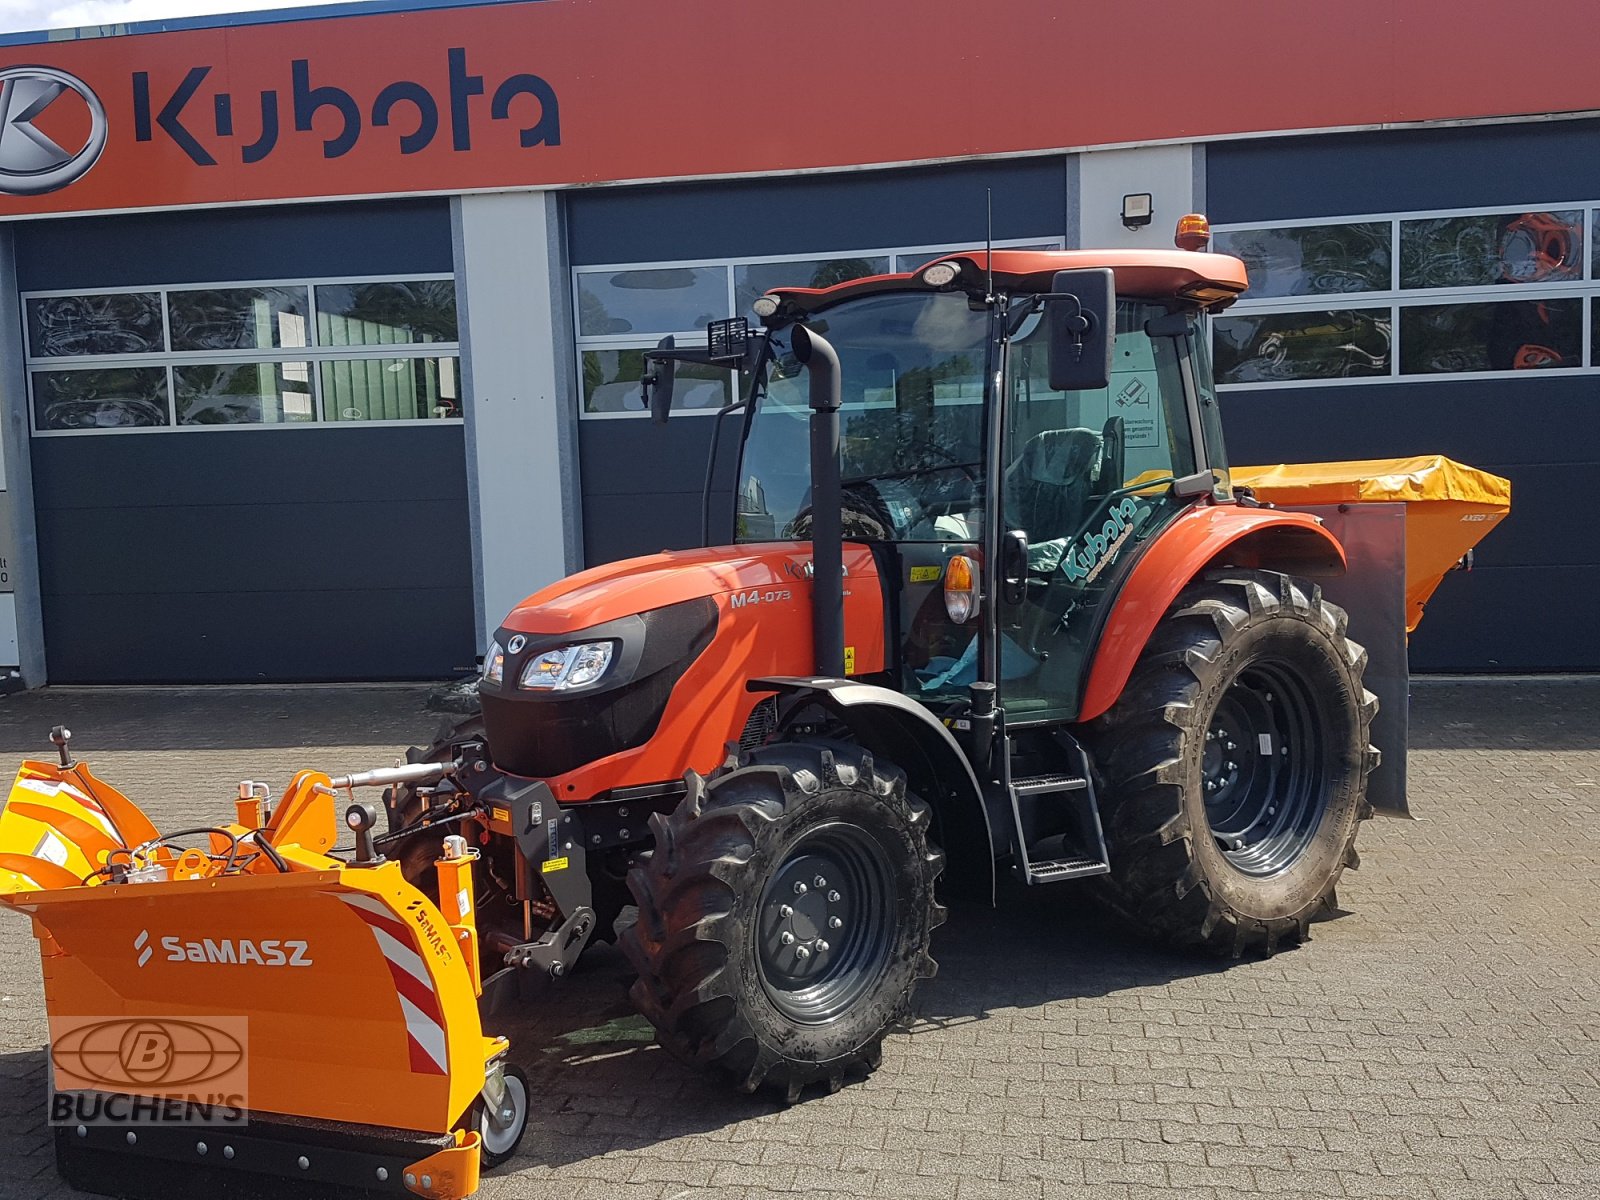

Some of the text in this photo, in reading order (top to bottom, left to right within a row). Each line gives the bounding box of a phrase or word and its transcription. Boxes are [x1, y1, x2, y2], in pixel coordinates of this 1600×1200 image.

[132, 47, 561, 166] Kubota
[1060, 497, 1138, 583] Kubota
[730, 590, 792, 609] M4-073
[161, 936, 313, 967] SaMASZ
